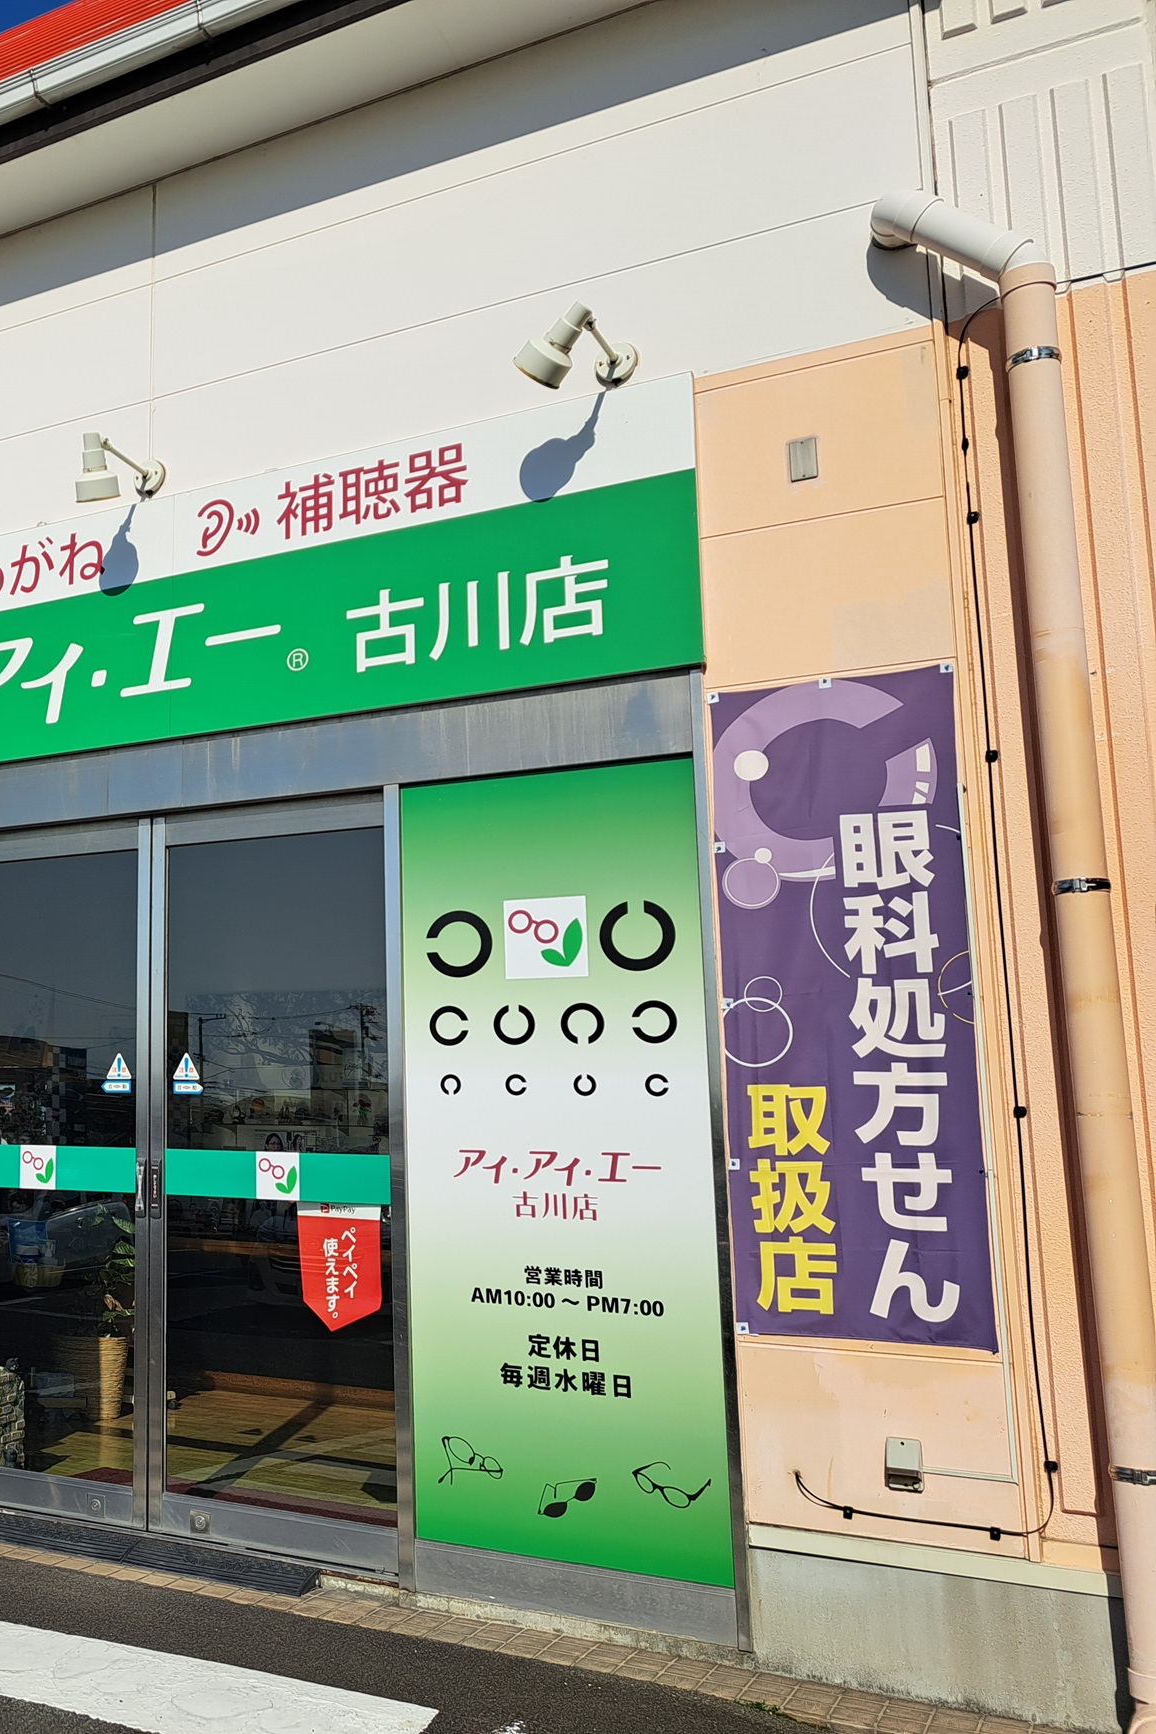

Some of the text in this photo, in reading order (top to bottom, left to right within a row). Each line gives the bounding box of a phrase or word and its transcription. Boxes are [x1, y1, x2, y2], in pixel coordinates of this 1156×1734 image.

[277, 441, 468, 540] 補聴器
[345, 555, 609, 673] 古川店
[839, 809, 962, 1323] 眼科処方せん
[331, 1204, 356, 1214] PayPay
[512, 1191, 598, 1221] 古川店
[747, 1082, 838, 1315] 取扱店
[323, 1237, 340, 1319] 使えます。
[341, 1226, 359, 1299] ペイペイ
[524, 1265, 604, 1290] 営業時間
[471, 1287, 556, 1309] AM10:00
[587, 1295, 664, 1317] PM7:00
[528, 1333, 600, 1363] 定休日
[500, 1362, 632, 1399] 毎週水曜日
